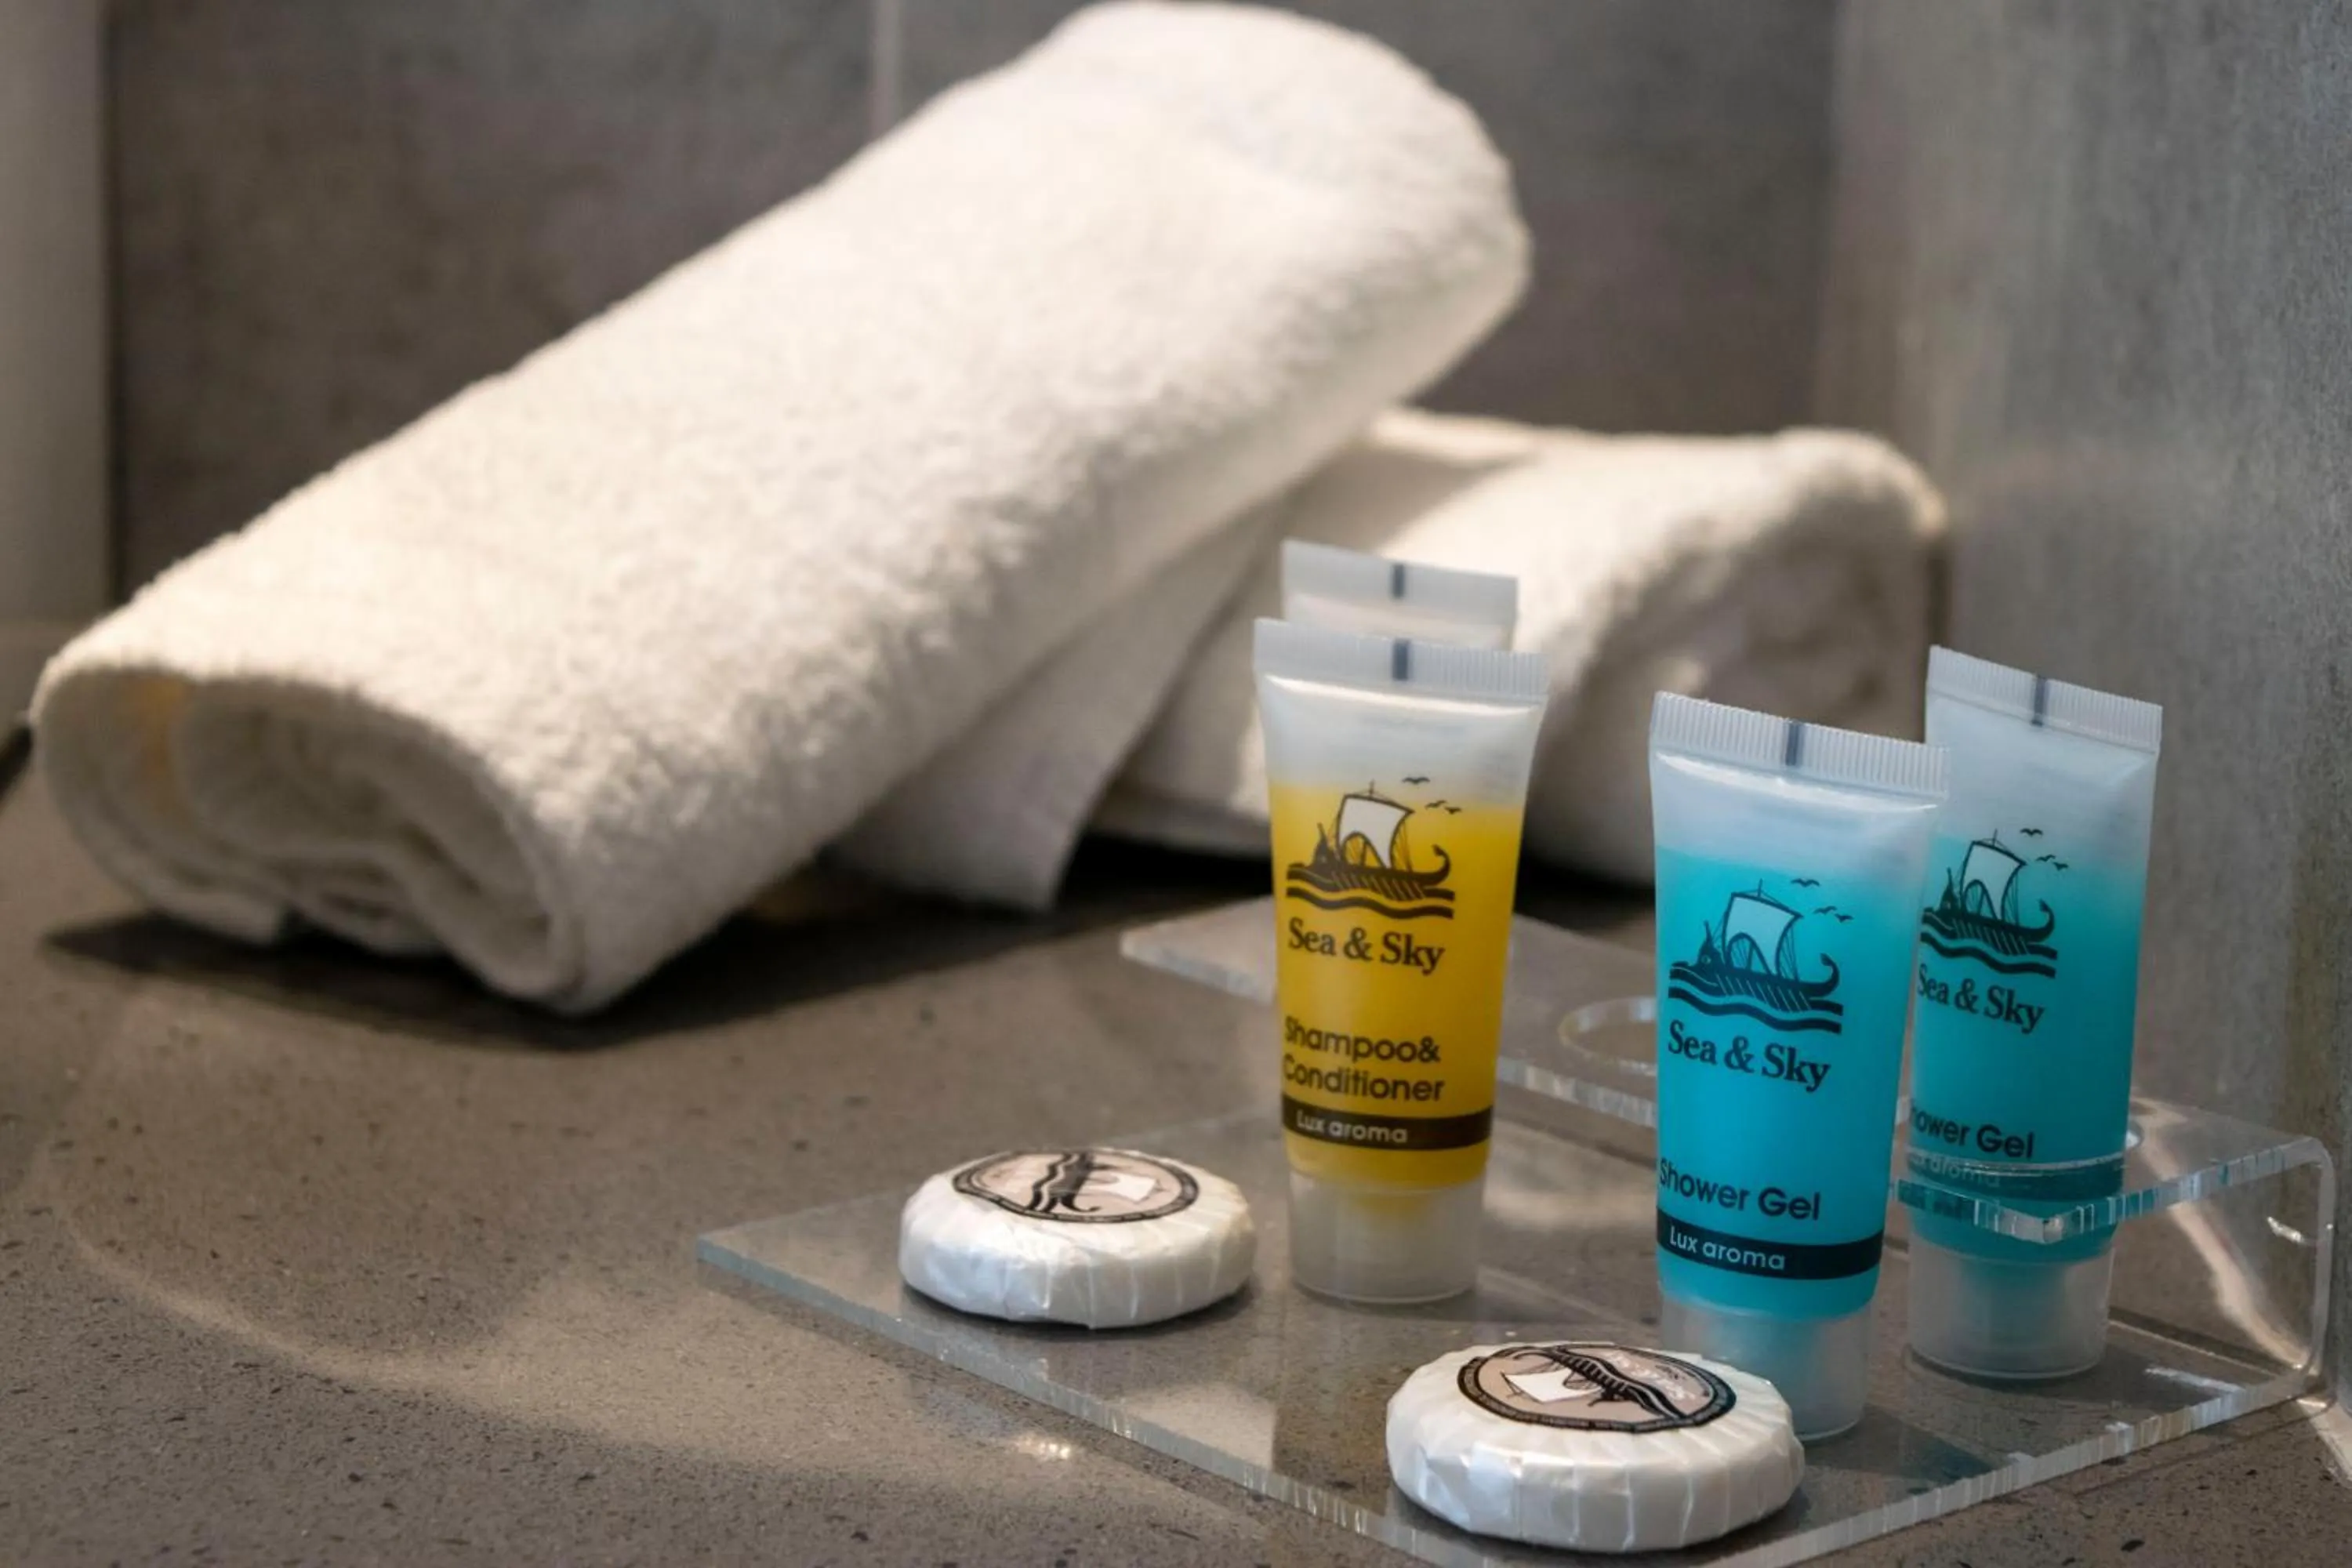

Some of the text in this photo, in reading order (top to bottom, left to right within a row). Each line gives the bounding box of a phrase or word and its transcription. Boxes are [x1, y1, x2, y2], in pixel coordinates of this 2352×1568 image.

[1288, 916, 1446, 976] Sea & Sky
[1918, 963, 2045, 1034] Sea & Sky
[1285, 1015, 1442, 1064] Shampoo&
[1668, 1020, 1831, 1093] Sea & Sky
[1283, 1053, 1446, 1102] Conditioner
[1296, 1110, 1408, 1144] Lux aroma
[1976, 1123, 2034, 1159] Gel
[1659, 1157, 1821, 1221] Shower Gel
[1669, 1225, 1786, 1270] Lux aroma
